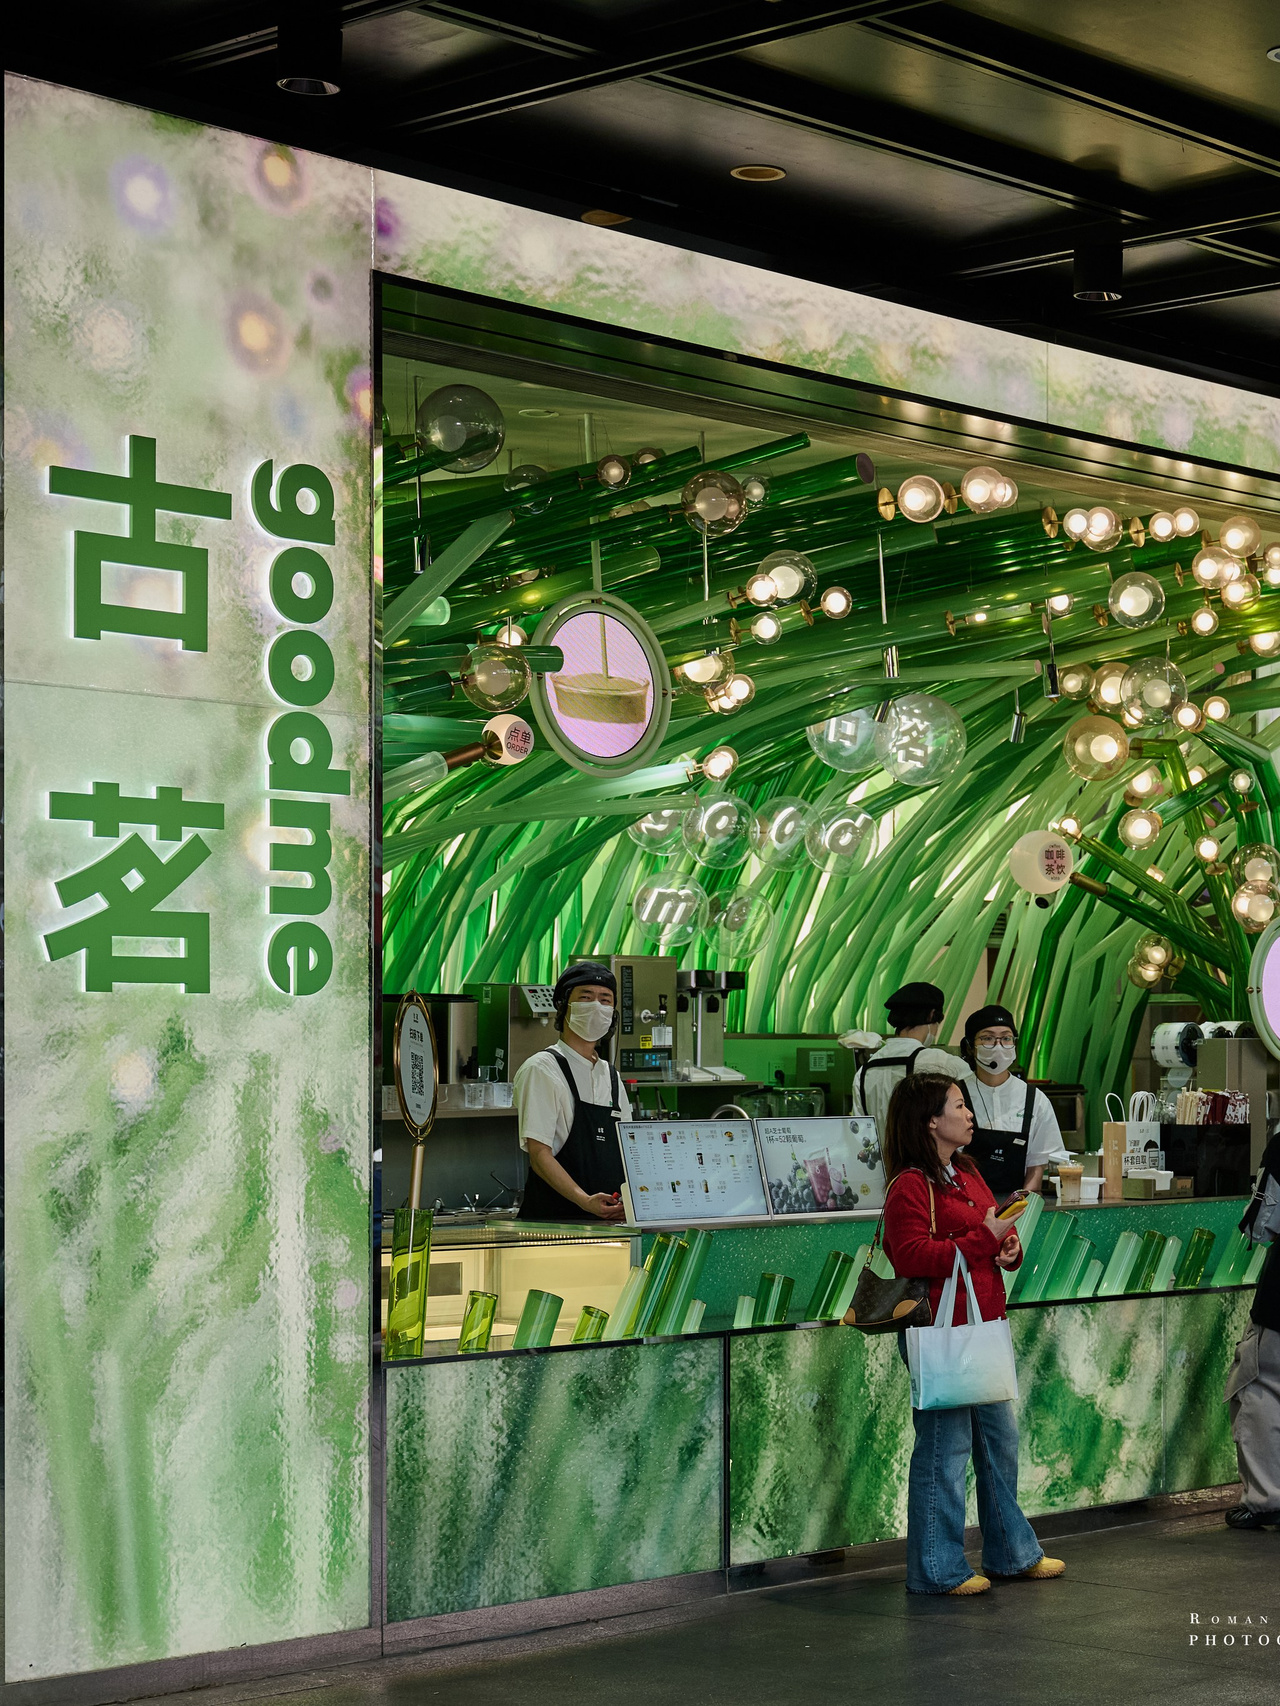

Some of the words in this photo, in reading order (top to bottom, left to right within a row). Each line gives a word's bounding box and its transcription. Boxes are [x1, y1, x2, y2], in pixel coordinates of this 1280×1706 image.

[45, 435, 232, 993] 古茗
[250, 459, 350, 995] goodme
[508, 727, 531, 744] 点单
[507, 742, 529, 755] ORDER
[1045, 849, 1065, 860] 咖啡
[1045, 864, 1065, 875] 茶饮
[1124, 1155, 1147, 1165] 杯套自取
